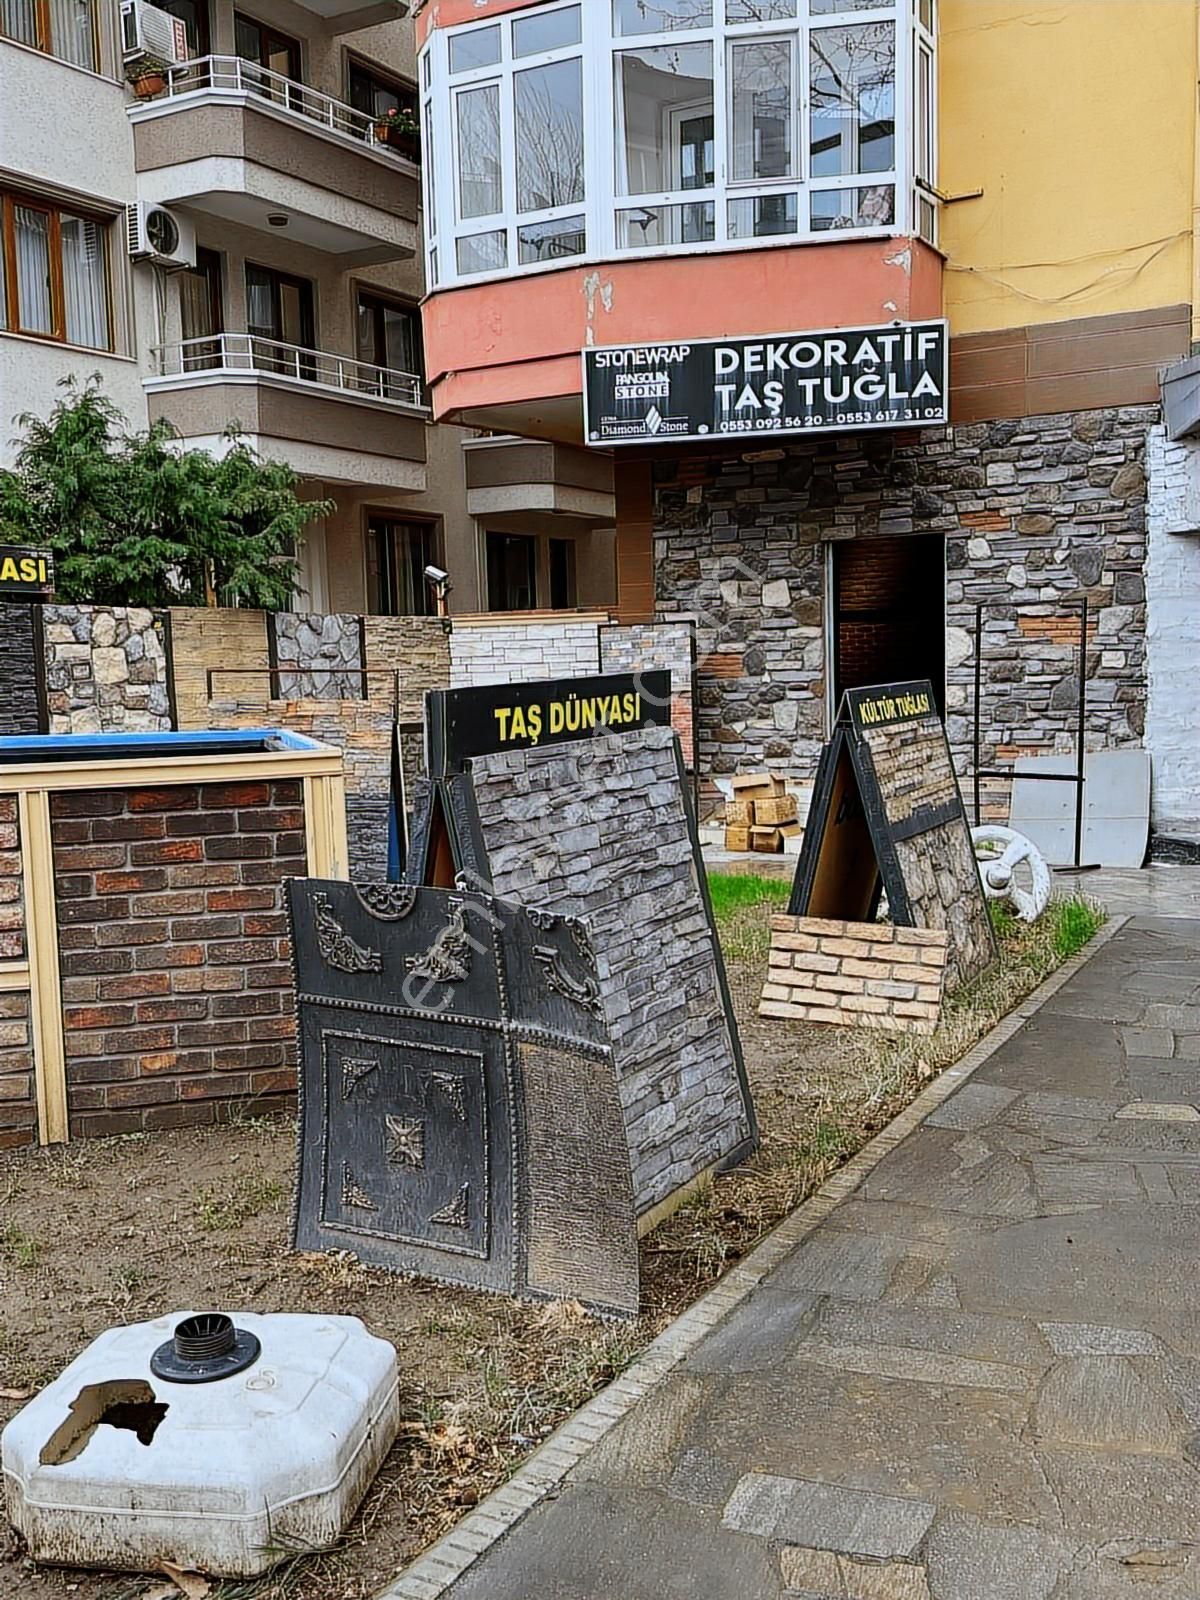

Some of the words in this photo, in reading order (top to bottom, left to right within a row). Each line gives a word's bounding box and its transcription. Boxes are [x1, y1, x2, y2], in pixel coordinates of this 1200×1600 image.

[714, 328, 939, 375] DEKORATİF
[616, 385, 668, 398] STONE
[714, 381, 784, 416] TAŞ
[798, 367, 941, 406] TUĞLA
[601, 421, 646, 435] Diamond
[659, 420, 689, 432] Stone
[720, 419, 752, 433] 0553
[756, 418, 782, 430] 092
[785, 416, 801, 427] 56
[804, 415, 823, 426] 20
[836, 411, 872, 424] 0553
[875, 409, 899, 421] 617
[924, 407, 943, 418] 02
[494, 704, 542, 745] TAŞ
[550, 693, 641, 734] DÜNYASI
